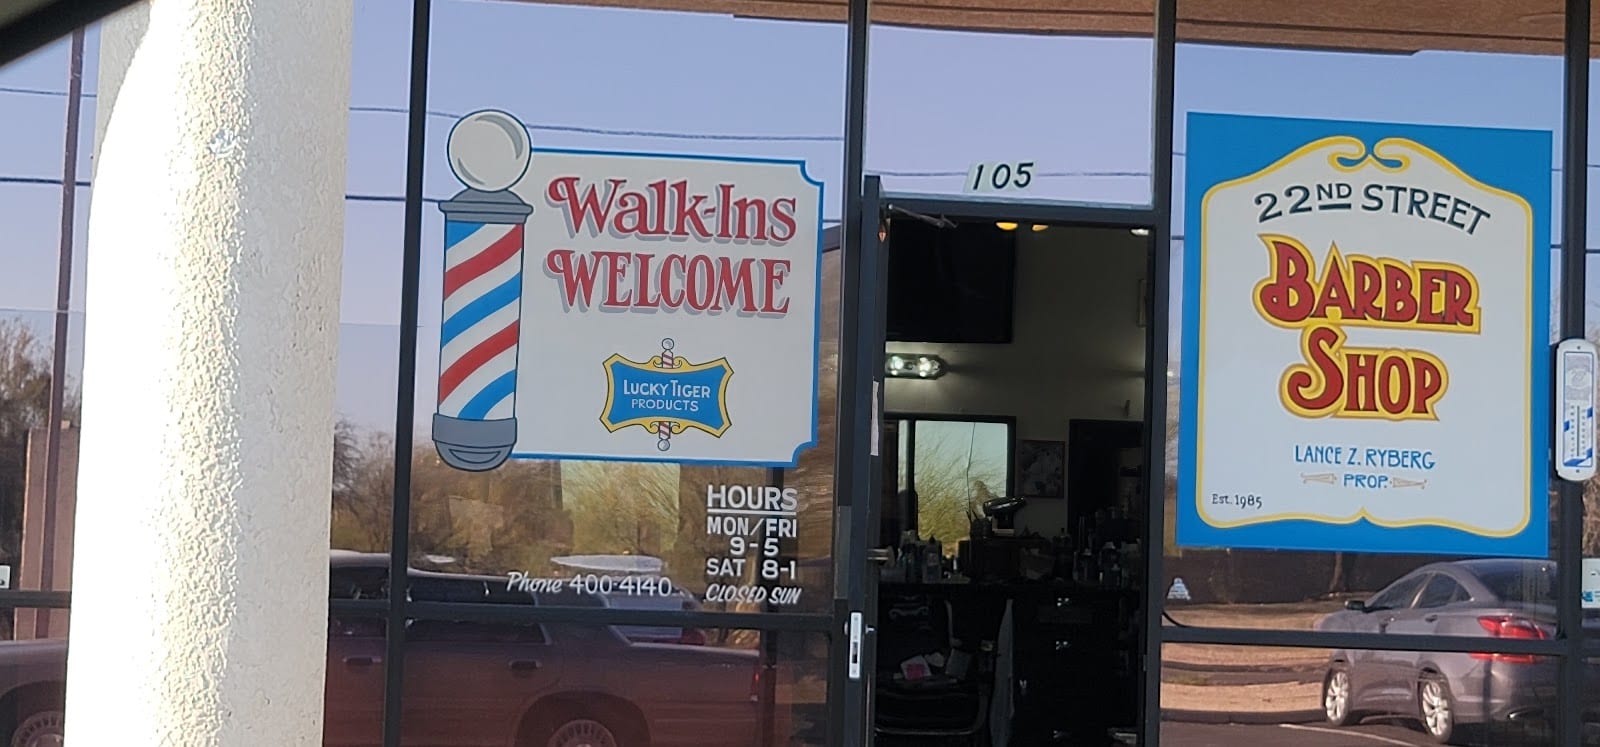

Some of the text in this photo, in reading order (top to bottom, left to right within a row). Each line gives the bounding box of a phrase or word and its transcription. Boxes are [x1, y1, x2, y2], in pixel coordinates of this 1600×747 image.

[972, 161, 1035, 191] 105
[546, 176, 798, 244] Walk-Ins
[1254, 183, 1491, 235] 22ND STREET
[545, 249, 792, 316] WELCOME
[623, 379, 711, 399] LUCKY TIGER
[631, 398, 699, 412] PRODUCTS
[1295, 445, 1436, 469] LANCE Z. RYBERG
[1343, 473, 1388, 489] PROP.
[706, 484, 798, 511] HOURS
[1212, 493, 1263, 510] Est. 1985
[707, 516, 797, 538] MON/FRI
[706, 557, 796, 580] SAT 8-1
[506, 571, 672, 597] Phone 400-4140
[705, 583, 802, 605] CLOSED SUN
